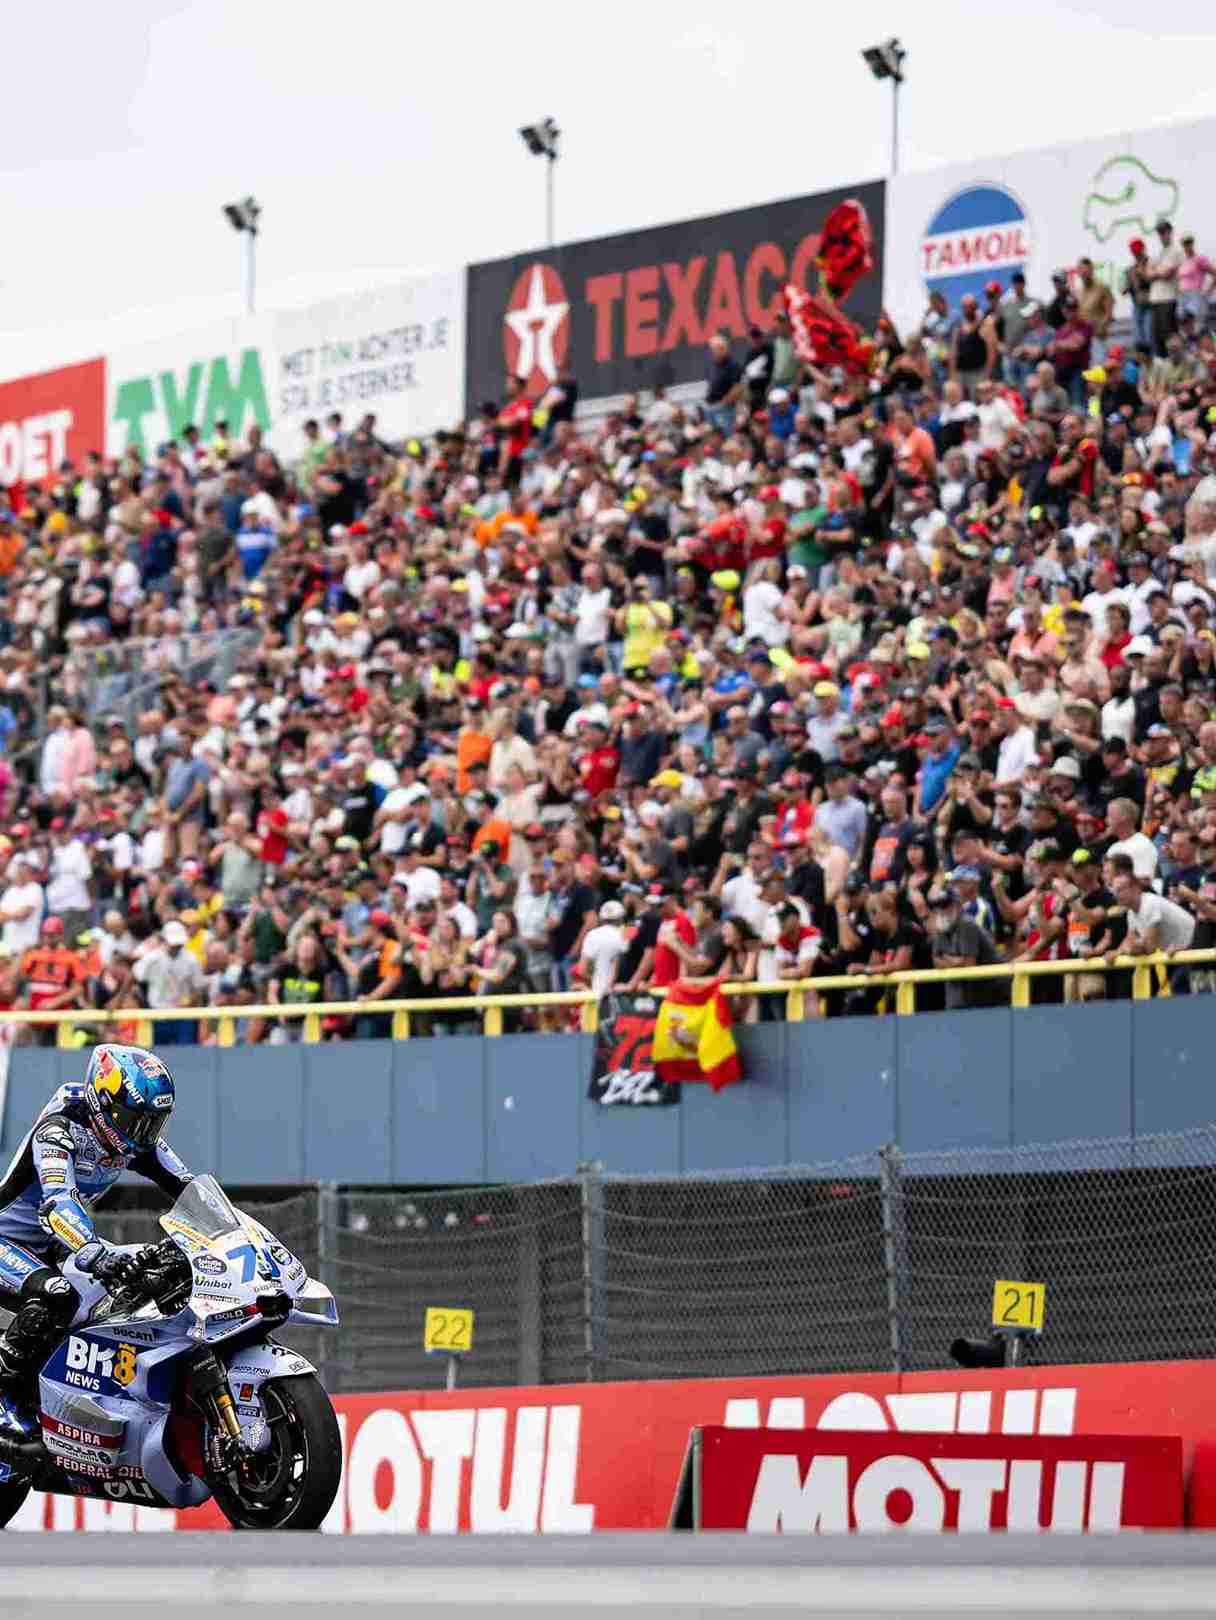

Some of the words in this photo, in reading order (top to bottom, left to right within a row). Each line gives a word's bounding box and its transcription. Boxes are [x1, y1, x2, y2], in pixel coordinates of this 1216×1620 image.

[922, 228, 1026, 272] TAMOIL
[112, 346, 271, 466] TVM
[194, 1274, 233, 1290] Unibat
[1002, 1287, 1035, 1323] 21
[113, 1327, 154, 1341] DUCATI
[429, 1315, 466, 1345] 22
[66, 1335, 137, 1386] BK8
[65, 1370, 100, 1391] NEWS
[57, 1423, 101, 1447] ASPIRA
[55, 1455, 113, 1480] FEDERAL
[117, 1466, 144, 1480] OIL
[322, 1405, 595, 1536] OTUL
[746, 1454, 1145, 1535] MOTUL
